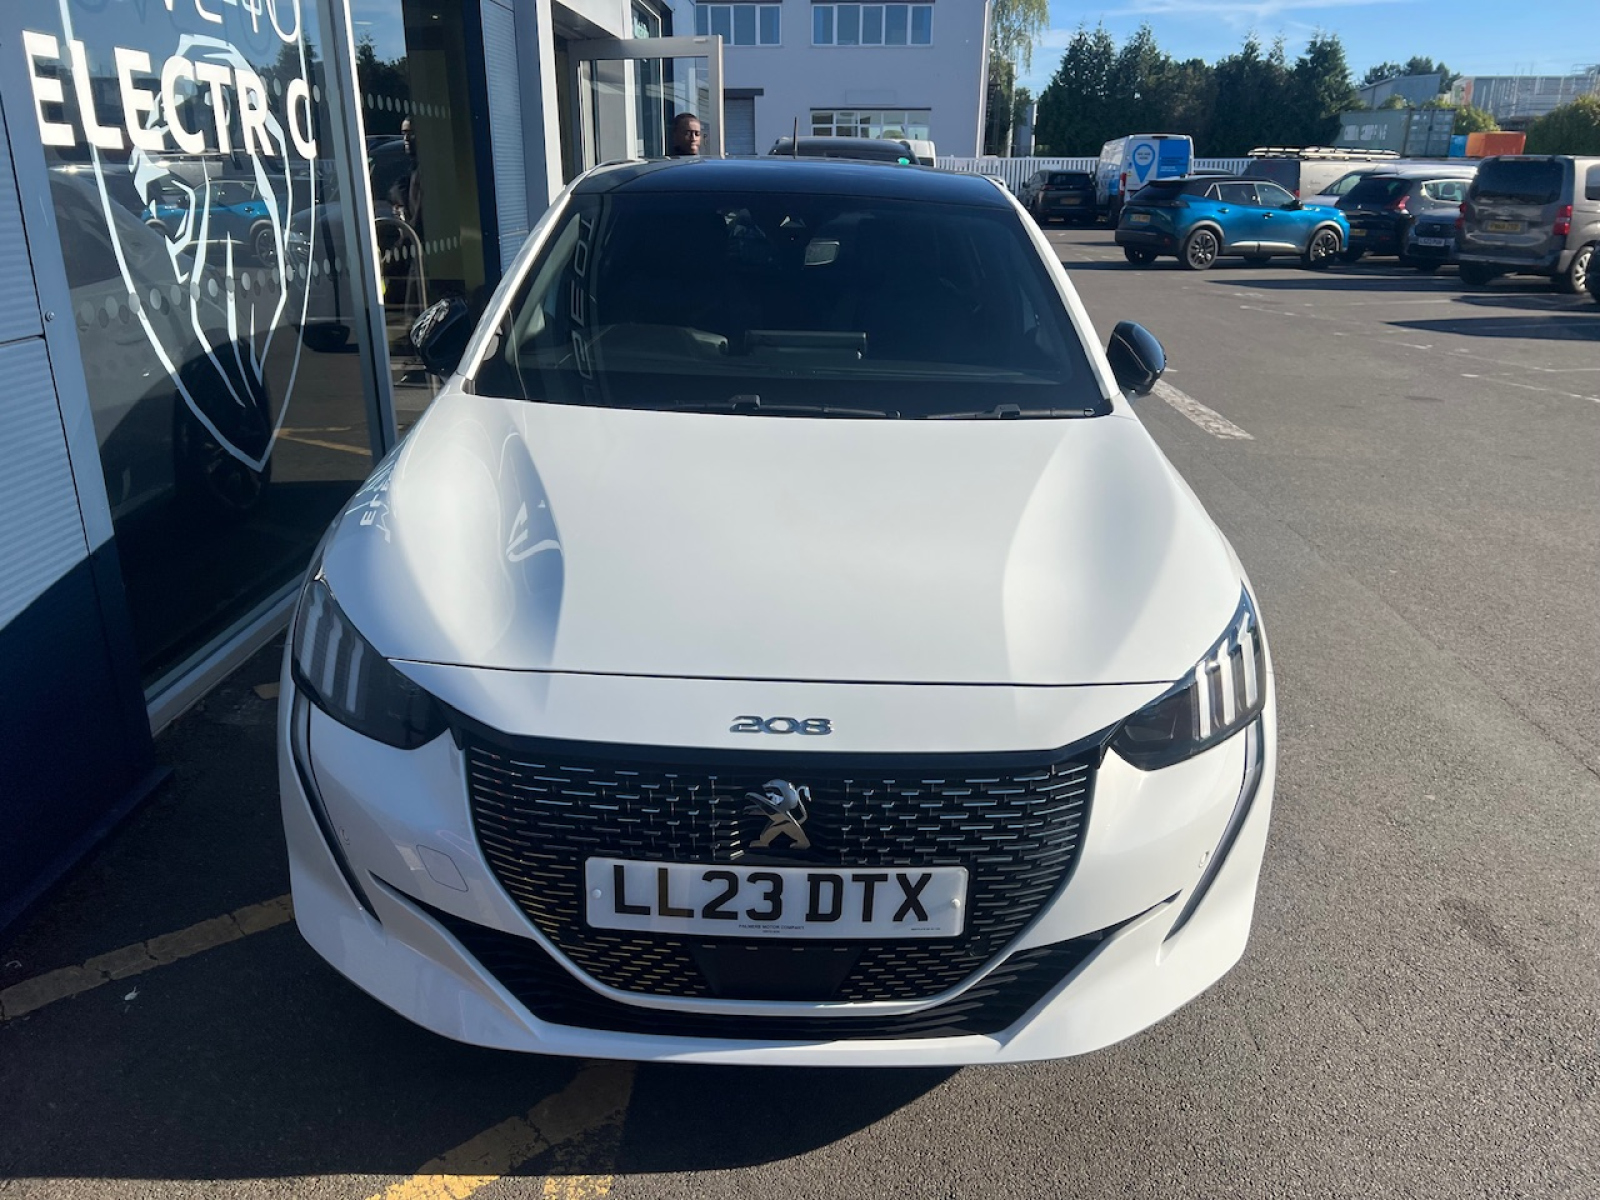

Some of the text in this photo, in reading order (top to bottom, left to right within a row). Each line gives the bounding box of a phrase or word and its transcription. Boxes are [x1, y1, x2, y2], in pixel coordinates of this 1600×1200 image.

[22, 30, 317, 160] ELECTRC
[729, 715, 833, 735] 208
[613, 864, 932, 922] LL23 DTX
